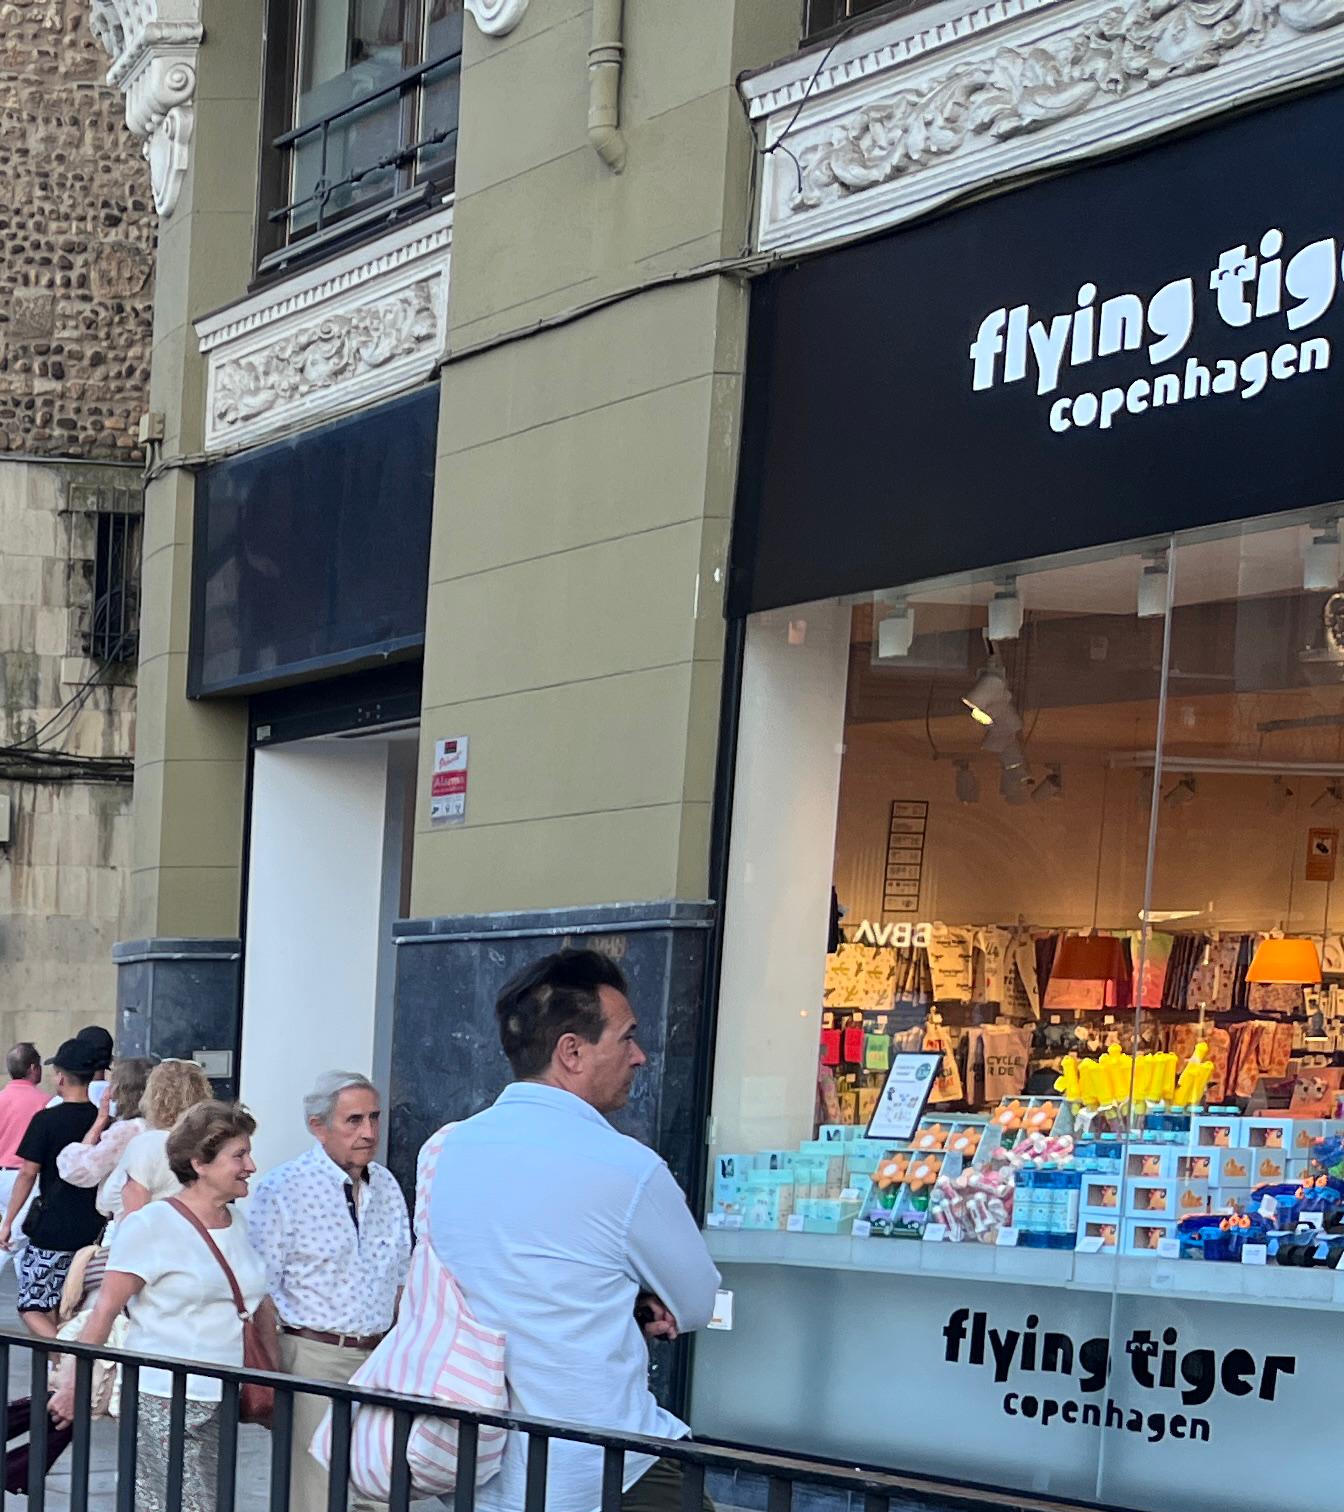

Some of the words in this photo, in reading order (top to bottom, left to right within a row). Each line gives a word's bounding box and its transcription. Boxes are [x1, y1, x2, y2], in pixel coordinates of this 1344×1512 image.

[969, 277, 1194, 396] flying
[1209, 228, 1344, 331] tig
[1049, 337, 1330, 433] copenhagen
[942, 1308, 1112, 1393] flying
[1125, 1327, 1296, 1406] tiger
[1002, 1392, 1210, 1443] copenhagen
